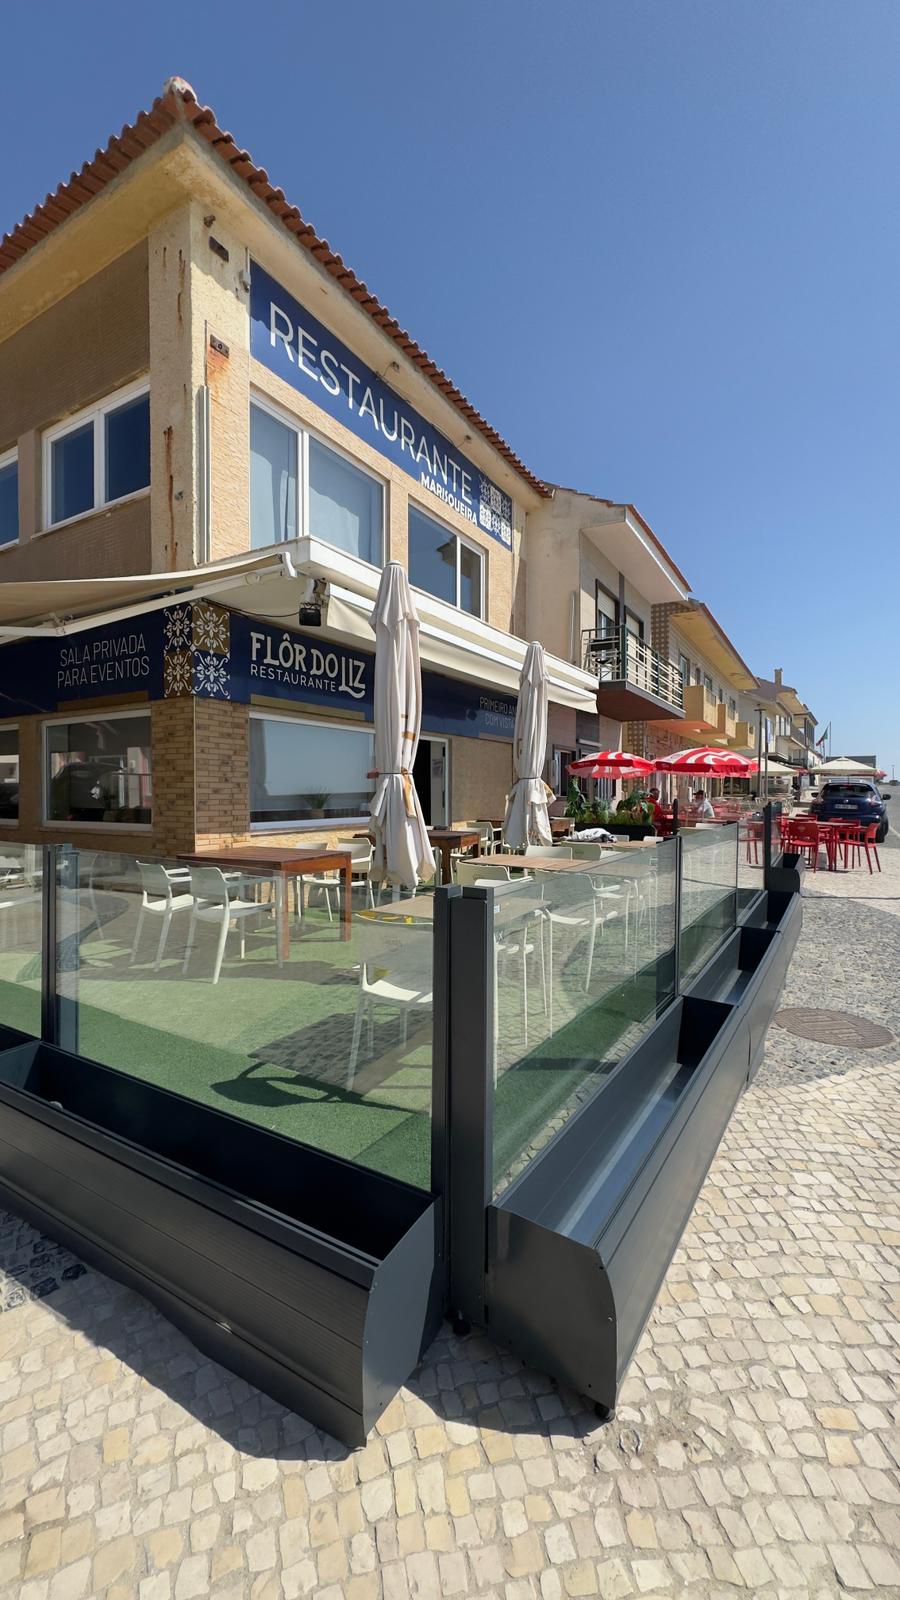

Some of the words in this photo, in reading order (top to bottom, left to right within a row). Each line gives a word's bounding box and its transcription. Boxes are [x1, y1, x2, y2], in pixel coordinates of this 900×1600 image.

[270, 302, 472, 505] RESTAURANTE
[421, 472, 478, 527] MARISQUEIRA
[60, 645, 90, 667] SALA
[93, 633, 146, 661] PRIVADA
[250, 632, 307, 672] FLÔR
[310, 648, 339, 678] DO
[338, 656, 366, 699] LIZ
[57, 668, 88, 689] PARA
[90, 656, 150, 684] EVENTOS
[250, 664, 336, 692] RESTAURANTE
[480, 696, 508, 715] PRIMEIRO
